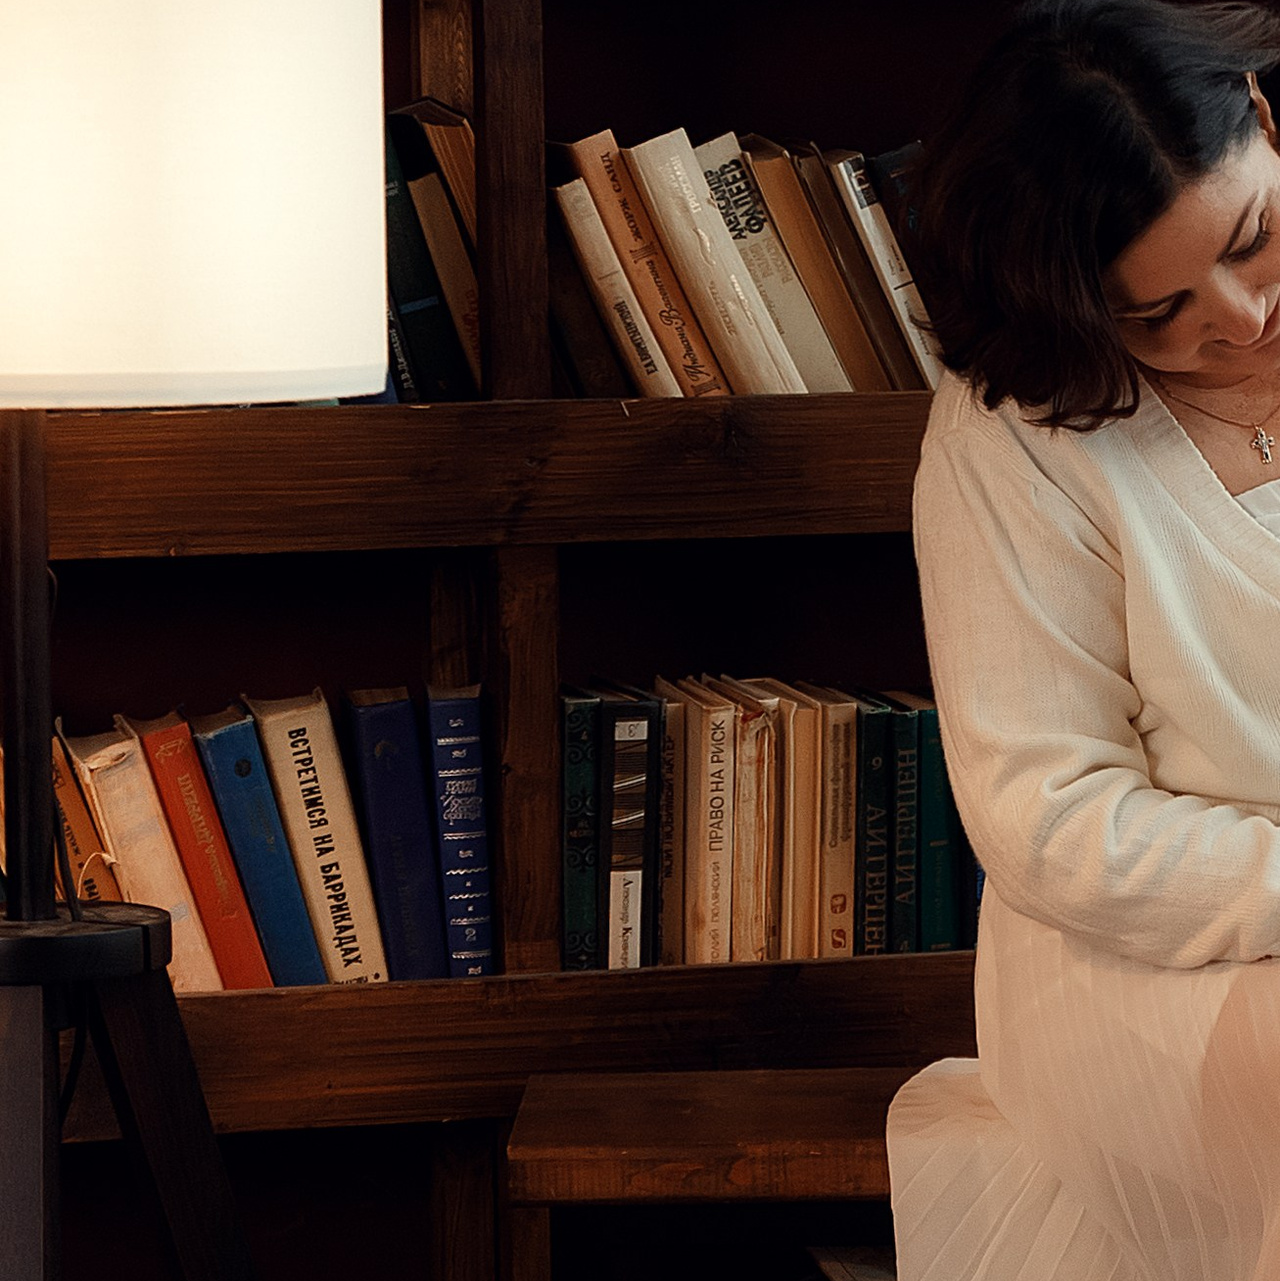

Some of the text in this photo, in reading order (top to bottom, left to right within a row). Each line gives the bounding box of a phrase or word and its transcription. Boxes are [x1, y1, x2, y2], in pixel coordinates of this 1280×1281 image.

[599, 151, 644, 242] ЖОРЖ САНД
[703, 169, 747, 241] АЛЕКСАНДР
[719, 157, 765, 235] ФАДЕЕВ
[712, 719, 727, 765] РИСК
[287, 726, 321, 830] ВСТРЕТИМСЯ
[711, 769, 725, 793] НА
[312, 831, 336, 860] НА
[708, 796, 725, 853] ПРАВО
[321, 860, 364, 969] БАРРИКАДАХ
[463, 927, 477, 943] 2
